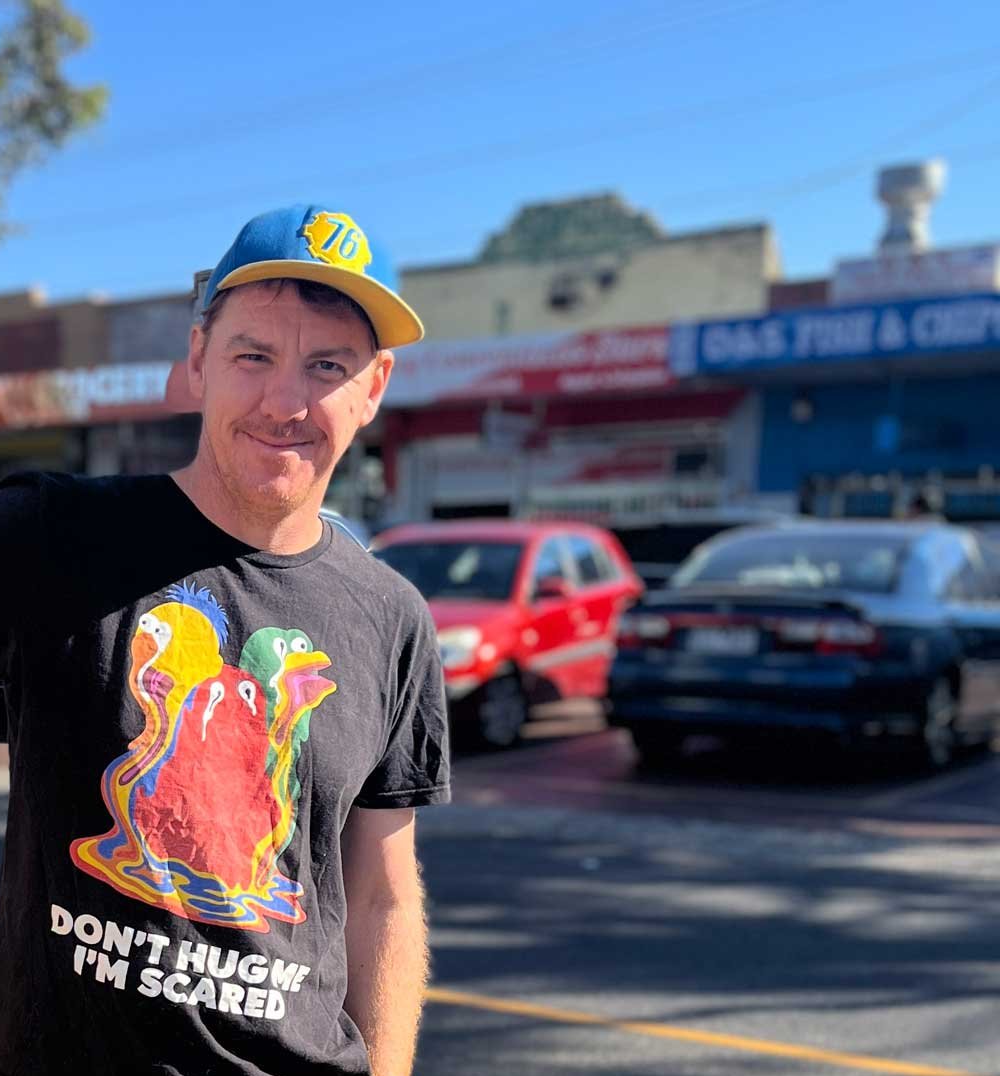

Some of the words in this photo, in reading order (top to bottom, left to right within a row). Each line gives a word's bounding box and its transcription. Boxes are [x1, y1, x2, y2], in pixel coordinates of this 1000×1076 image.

[321, 217, 360, 259] 76
[877, 307, 906, 350] &
[51, 904, 170, 965] DON'T
[175, 940, 269, 985] HUG
[270, 958, 311, 993] ME
[73, 945, 130, 990] I'M
[137, 967, 286, 1020] SCARED
